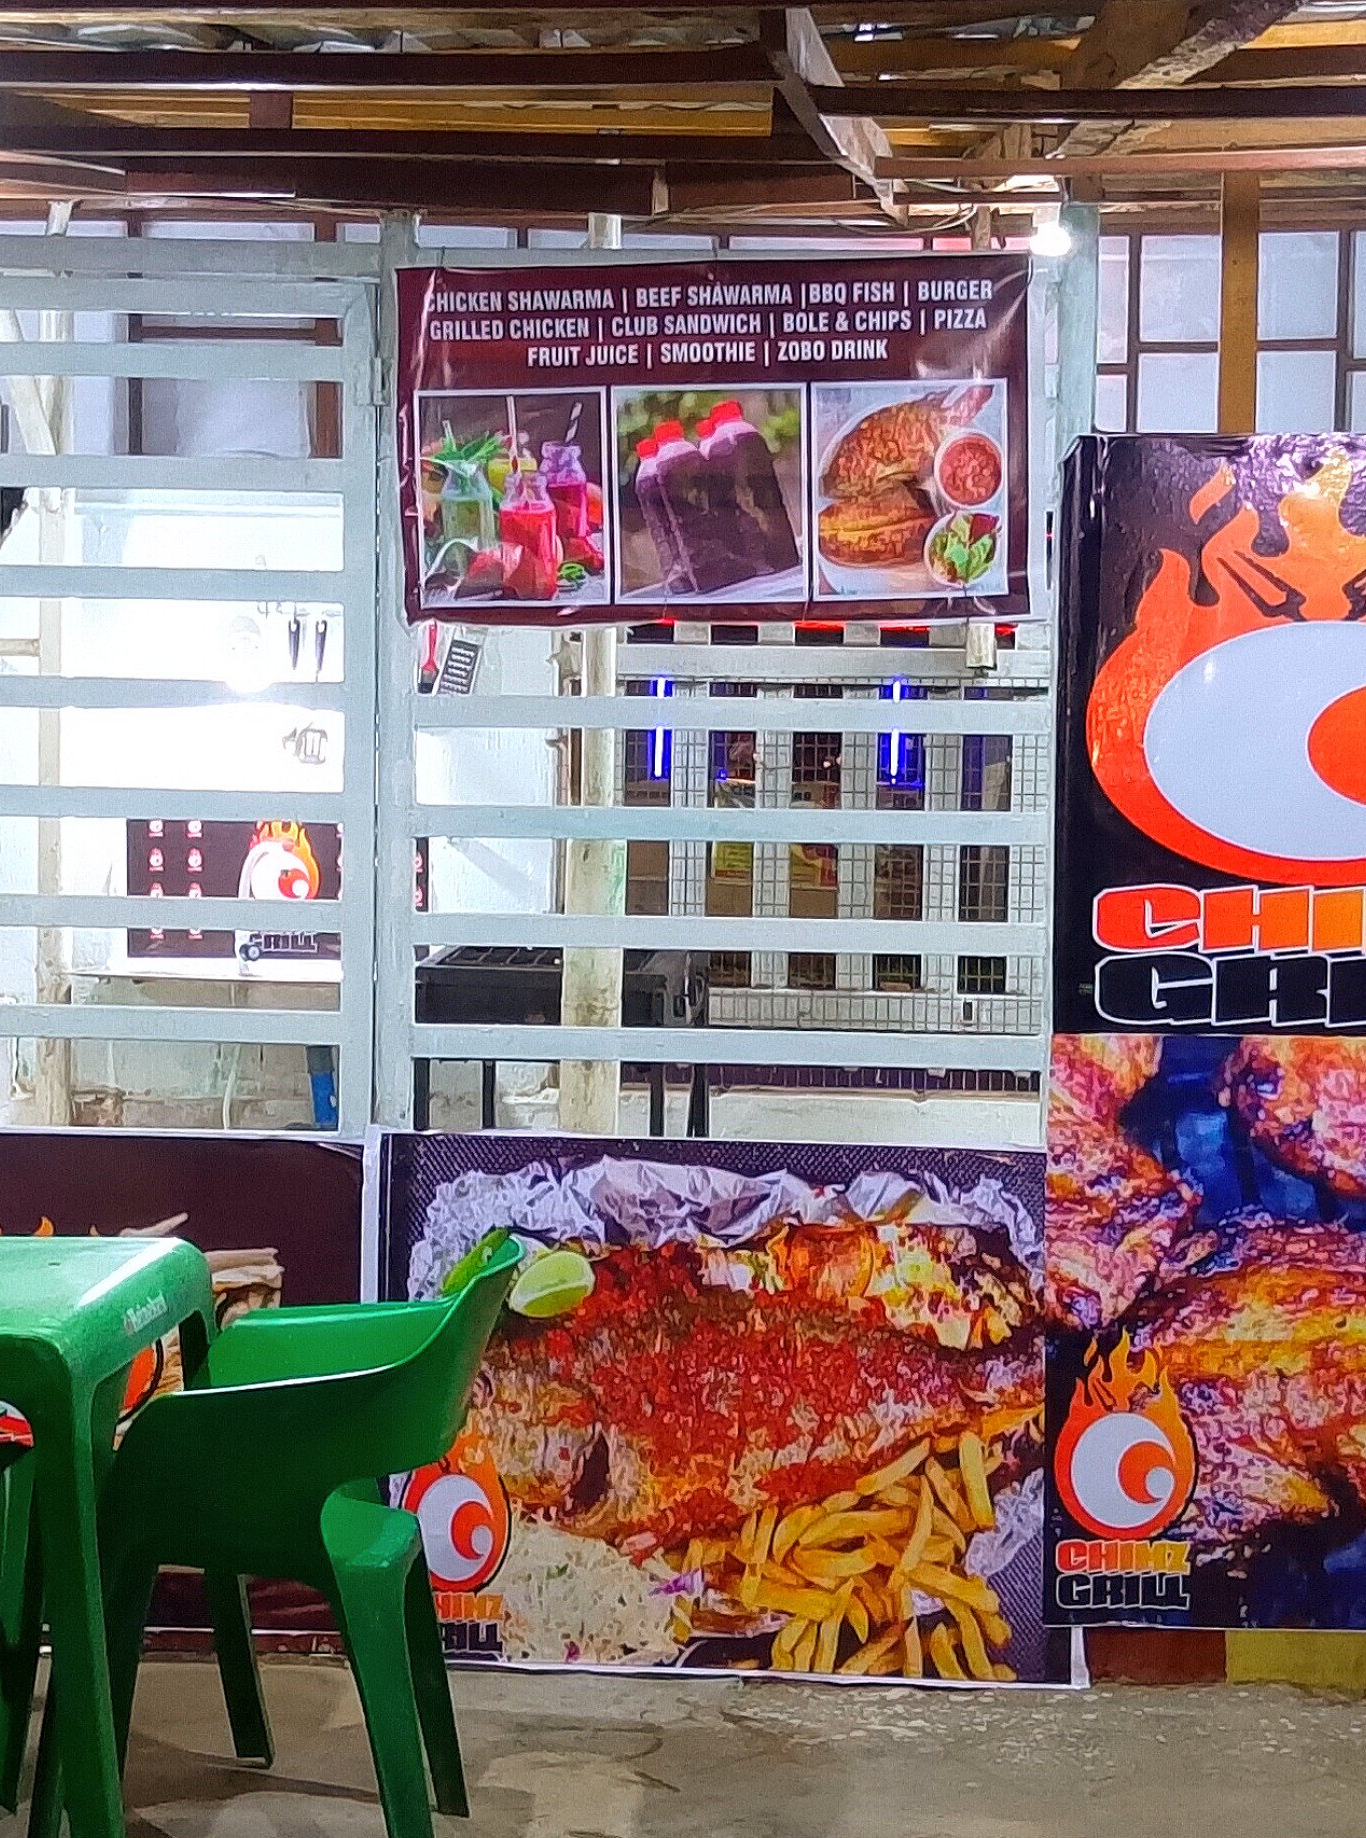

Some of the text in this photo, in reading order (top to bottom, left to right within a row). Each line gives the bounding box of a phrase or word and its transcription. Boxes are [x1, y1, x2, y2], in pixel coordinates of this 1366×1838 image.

[428, 291, 502, 313] CHICKEN
[508, 288, 615, 312] SHAWARMA
[636, 286, 682, 308] BEEF
[687, 283, 793, 308] SHAWARMA
[809, 282, 847, 305] BBQ
[852, 281, 895, 303] FISH
[917, 279, 994, 301] BURGER
[429, 319, 504, 341] GRILLED
[509, 316, 590, 340] CHICKEN
[611, 315, 658, 338] CLUB
[663, 312, 762, 336] SANDWICH
[782, 311, 830, 333] BOLE
[834, 310, 849, 332] &
[854, 308, 912, 331] CHIPS
[933, 307, 987, 330] PIZZA
[527, 346, 581, 368] FRUIT
[585, 344, 639, 367] JUICE
[660, 340, 756, 364] SMOOTHIE
[776, 339, 825, 362] ZOBO
[831, 338, 889, 361] DRINK
[1055, 1539, 1191, 1576] CHIMZ
[436, 1591, 504, 1621] HIMZ
[1055, 1572, 1190, 1611] GRILL
[440, 1620, 505, 1654] RILL
